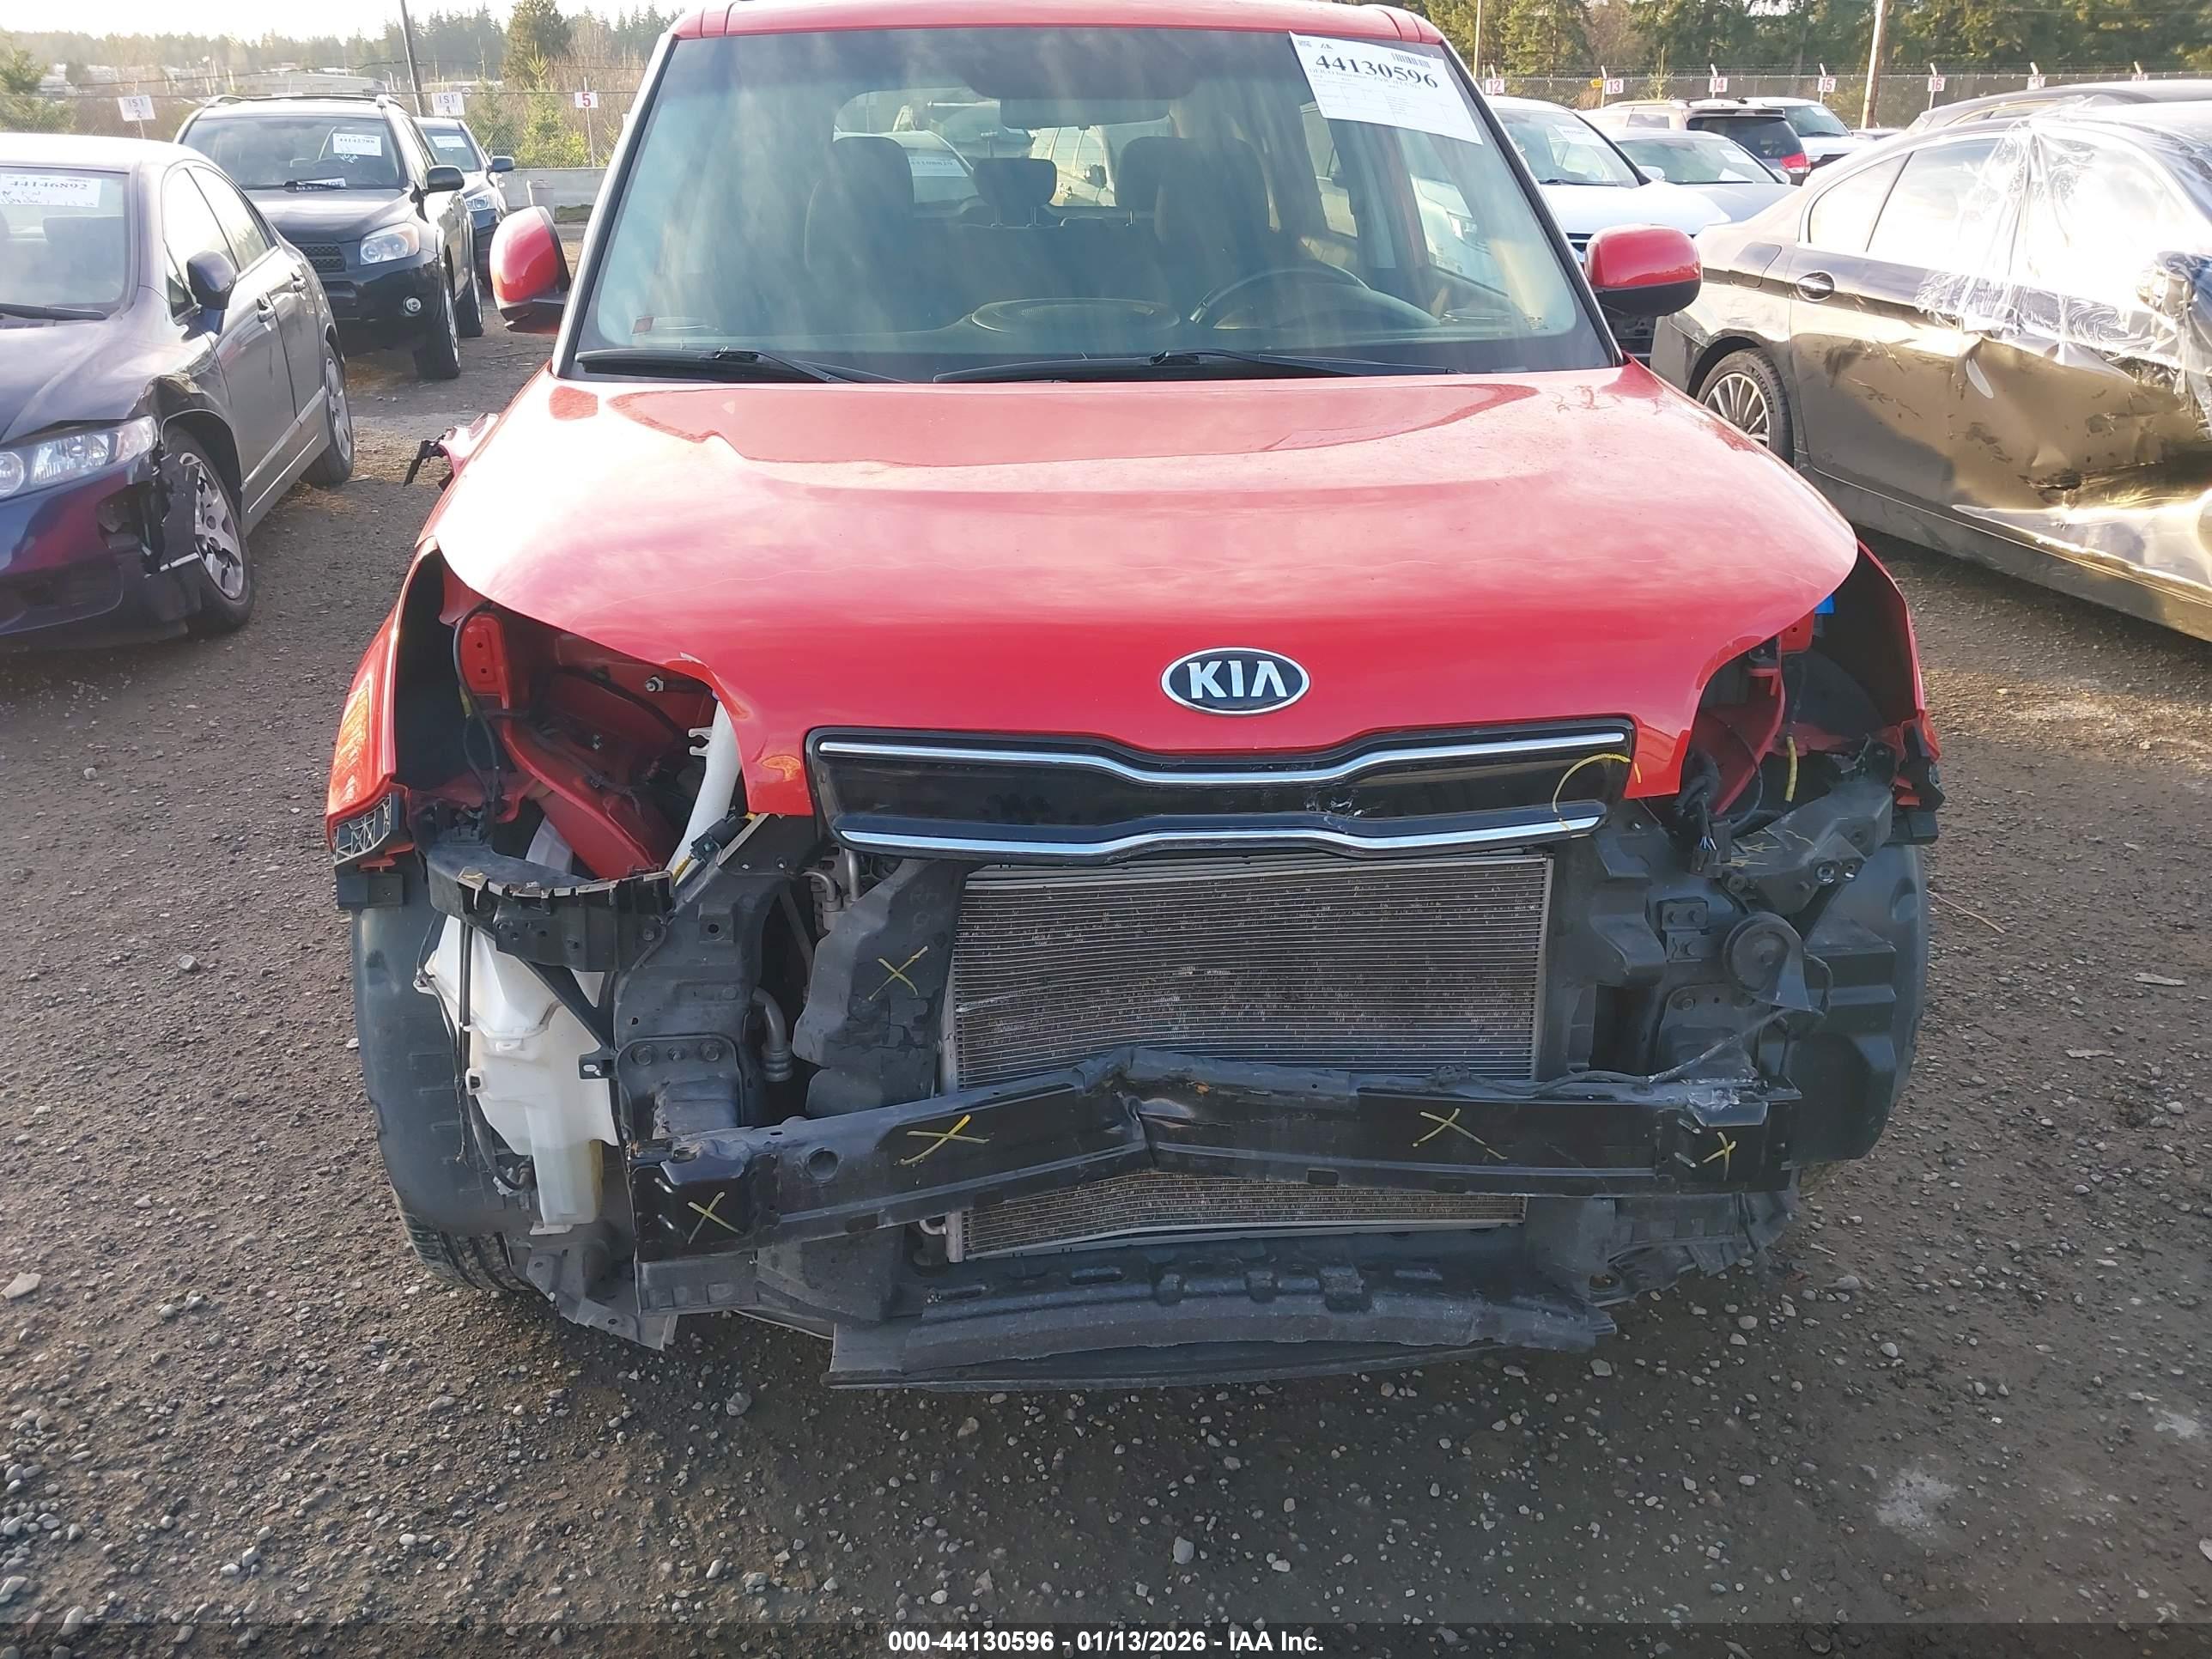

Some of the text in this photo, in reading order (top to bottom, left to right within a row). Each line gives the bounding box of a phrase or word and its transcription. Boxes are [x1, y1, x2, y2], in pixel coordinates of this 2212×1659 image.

[1316, 55, 1438, 88] 44130596
[1490, 80, 1501, 93] 12
[1609, 80, 1620, 93] 13
[1821, 79, 1832, 91] 15
[1931, 79, 1942, 91] 16
[581, 93, 592, 107] 5
[1187, 660, 1288, 699] KIA
